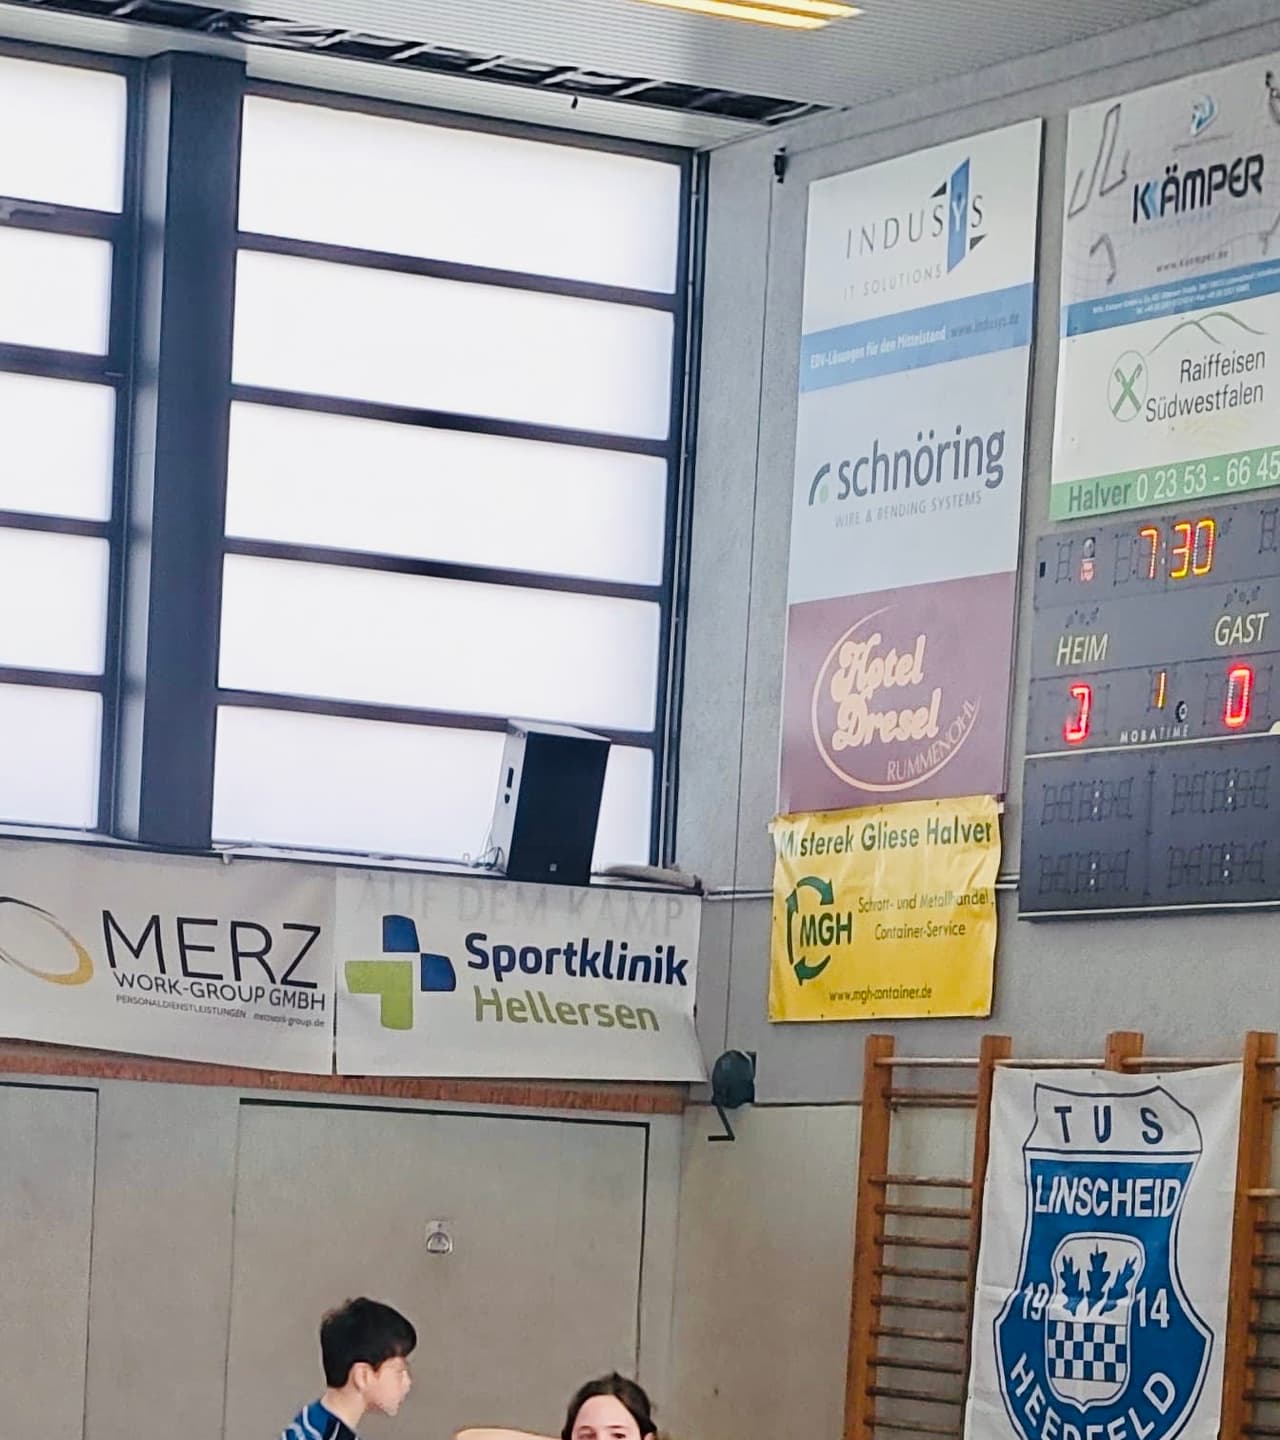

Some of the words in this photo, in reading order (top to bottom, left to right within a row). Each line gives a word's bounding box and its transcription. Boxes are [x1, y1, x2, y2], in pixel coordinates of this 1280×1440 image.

[845, 193, 985, 260] INDUSYS
[842, 287, 857, 300] IT
[863, 263, 943, 297] SOLUTIONS
[866, 340, 878, 360] für
[880, 337, 896, 354] den
[897, 325, 947, 350] Mittelstand
[1180, 348, 1266, 384] Raiffeisen
[1145, 380, 1264, 423] Südwestfalen
[837, 424, 1006, 501] schnöring
[1068, 482, 1132, 513] Halver
[1136, 472, 1149, 502] 0
[1153, 469, 1178, 499] 23
[1183, 462, 1207, 493] 53
[1226, 455, 1251, 486] 66
[1256, 449, 1280, 481] 45
[931, 490, 982, 513] SYSTEMS
[1139, 518, 1217, 580] 7:30
[1056, 633, 1110, 667] HEIM
[1214, 611, 1270, 647] GAST
[831, 632, 927, 703] Hotel
[831, 687, 942, 751] Dresel
[1224, 665, 1254, 728] 0
[886, 699, 978, 782] RUMMENOHL
[1119, 723, 1190, 743] MOBATIME
[860, 821, 920, 852] Gliese
[926, 815, 993, 846] Halver
[896, 894, 917, 910] und
[101, 909, 322, 990] MERZ
[799, 911, 853, 948] MGH
[874, 920, 967, 941] Container-Service
[464, 931, 689, 987] Sportklinik
[113, 970, 266, 1005] WORK-GROUP
[269, 988, 326, 1012] GMBH
[473, 985, 660, 1033] Hellersen
[1033, 1174, 1183, 1218] LINSCHEID
[1022, 1281, 1049, 1321] 19
[1136, 1286, 1170, 1329] 14
